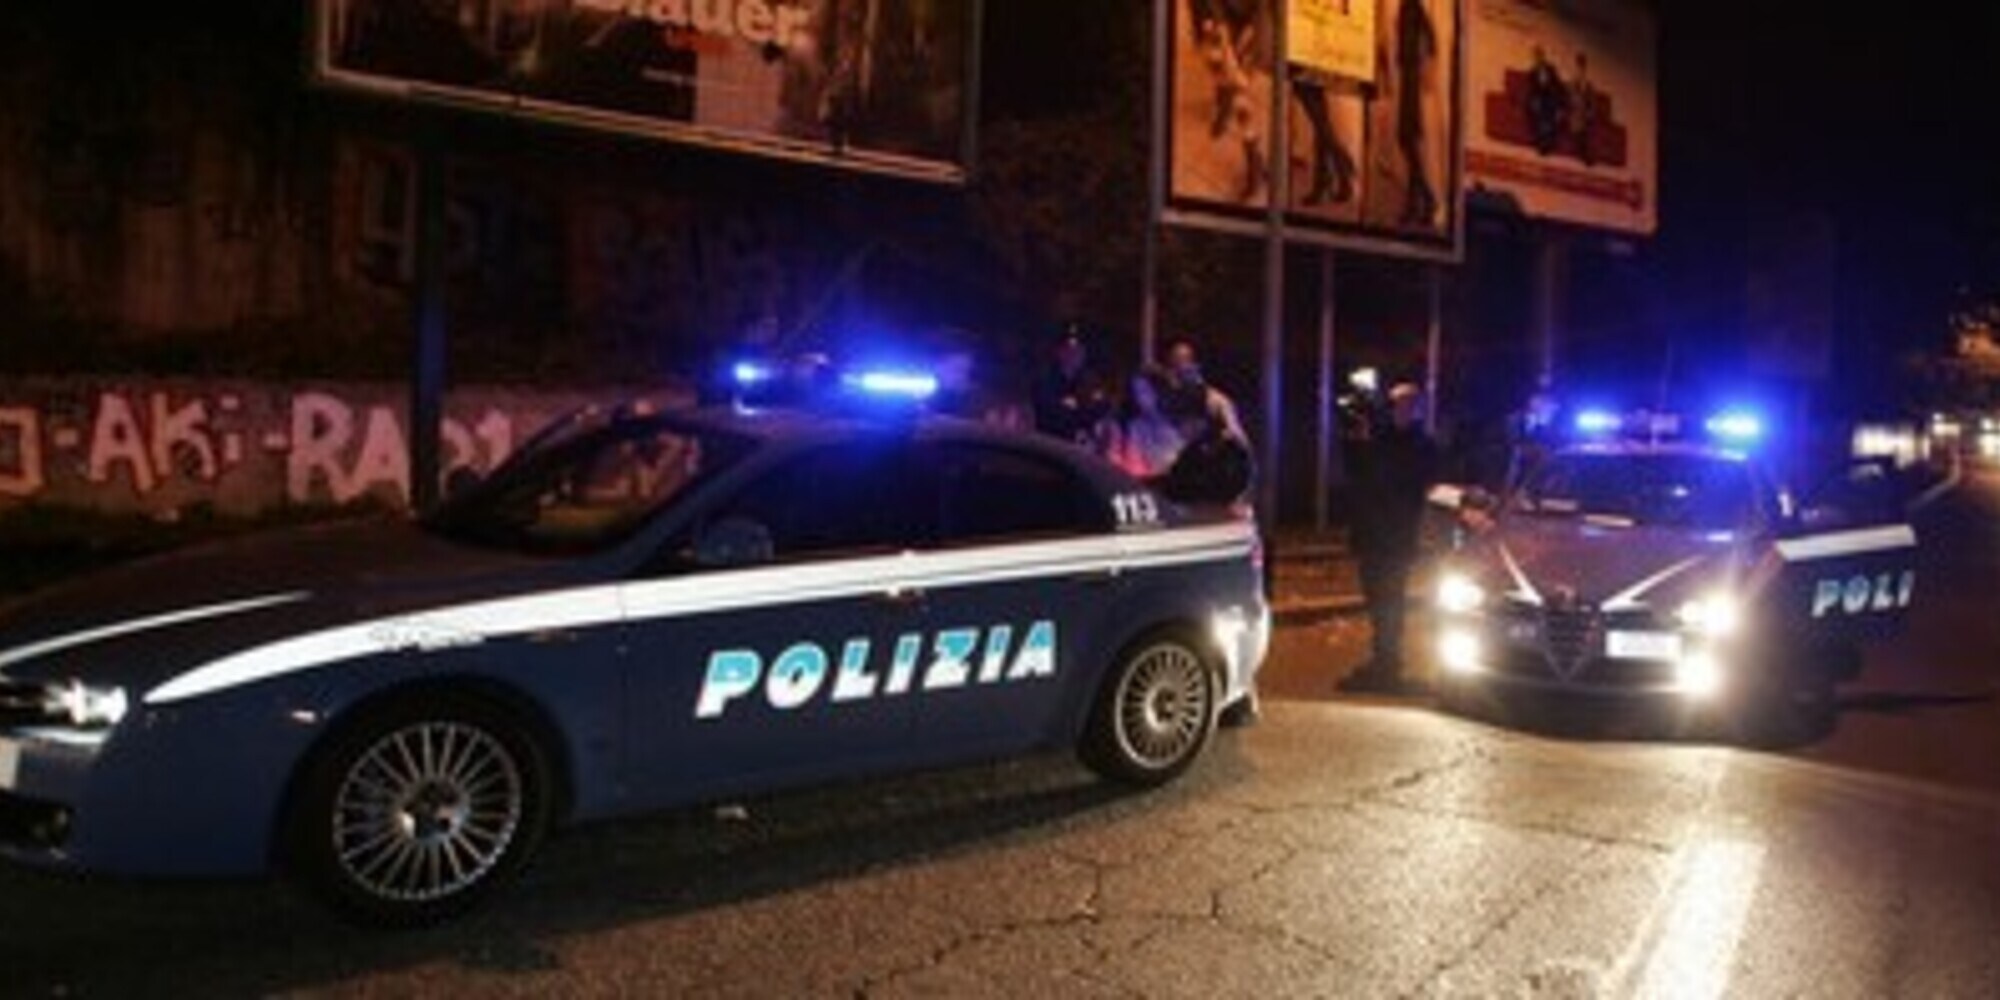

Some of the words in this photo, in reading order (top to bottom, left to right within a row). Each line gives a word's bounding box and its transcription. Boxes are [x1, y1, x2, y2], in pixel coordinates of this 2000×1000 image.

[1111, 493, 1158, 521] 113
[1811, 570, 1915, 618] POLI
[694, 619, 1056, 719] POLIZIA
